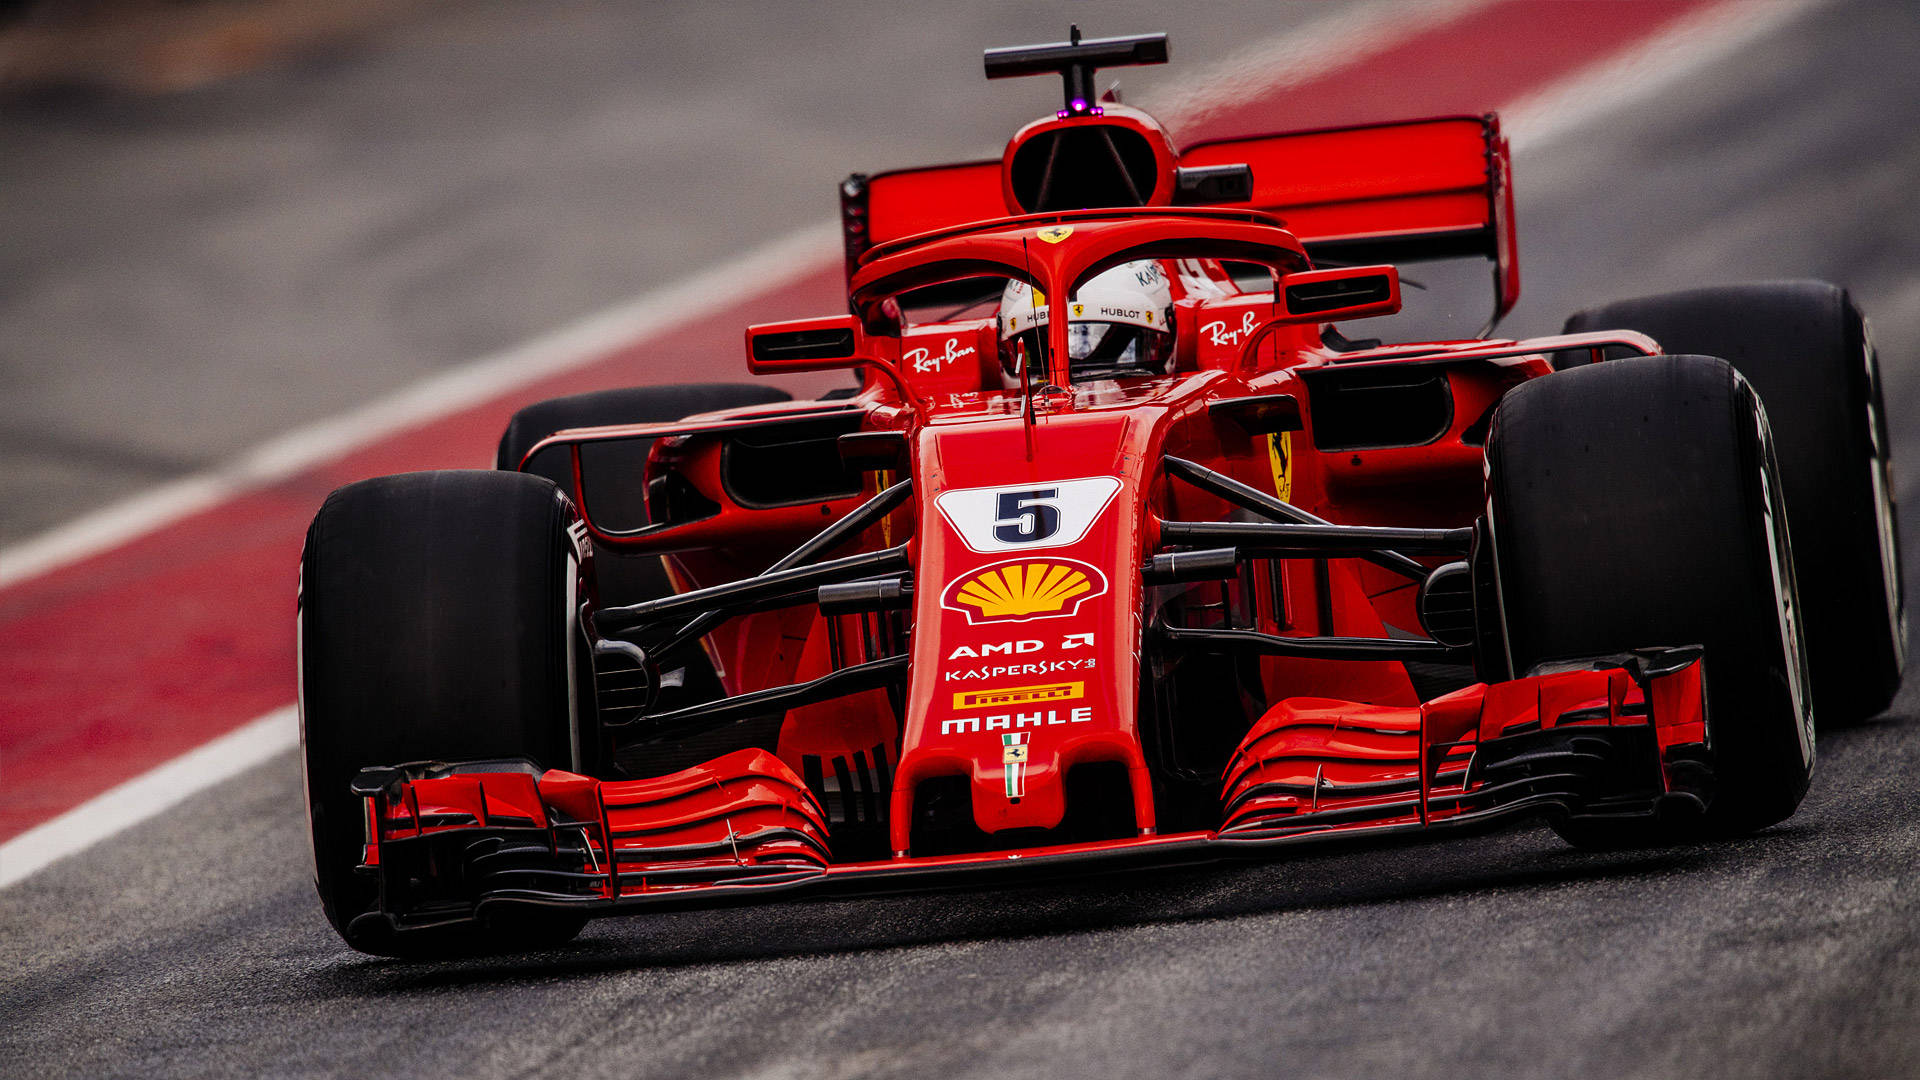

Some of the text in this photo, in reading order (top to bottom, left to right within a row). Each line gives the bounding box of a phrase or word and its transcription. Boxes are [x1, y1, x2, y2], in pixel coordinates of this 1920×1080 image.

[1101, 307, 1140, 319] HUBLOT
[903, 338, 975, 373] Ray-Ban
[993, 488, 1061, 543] 5
[948, 640, 1044, 660] AMD
[945, 659, 1083, 681] KASPERSKY
[964, 686, 1072, 705] PIRELLI
